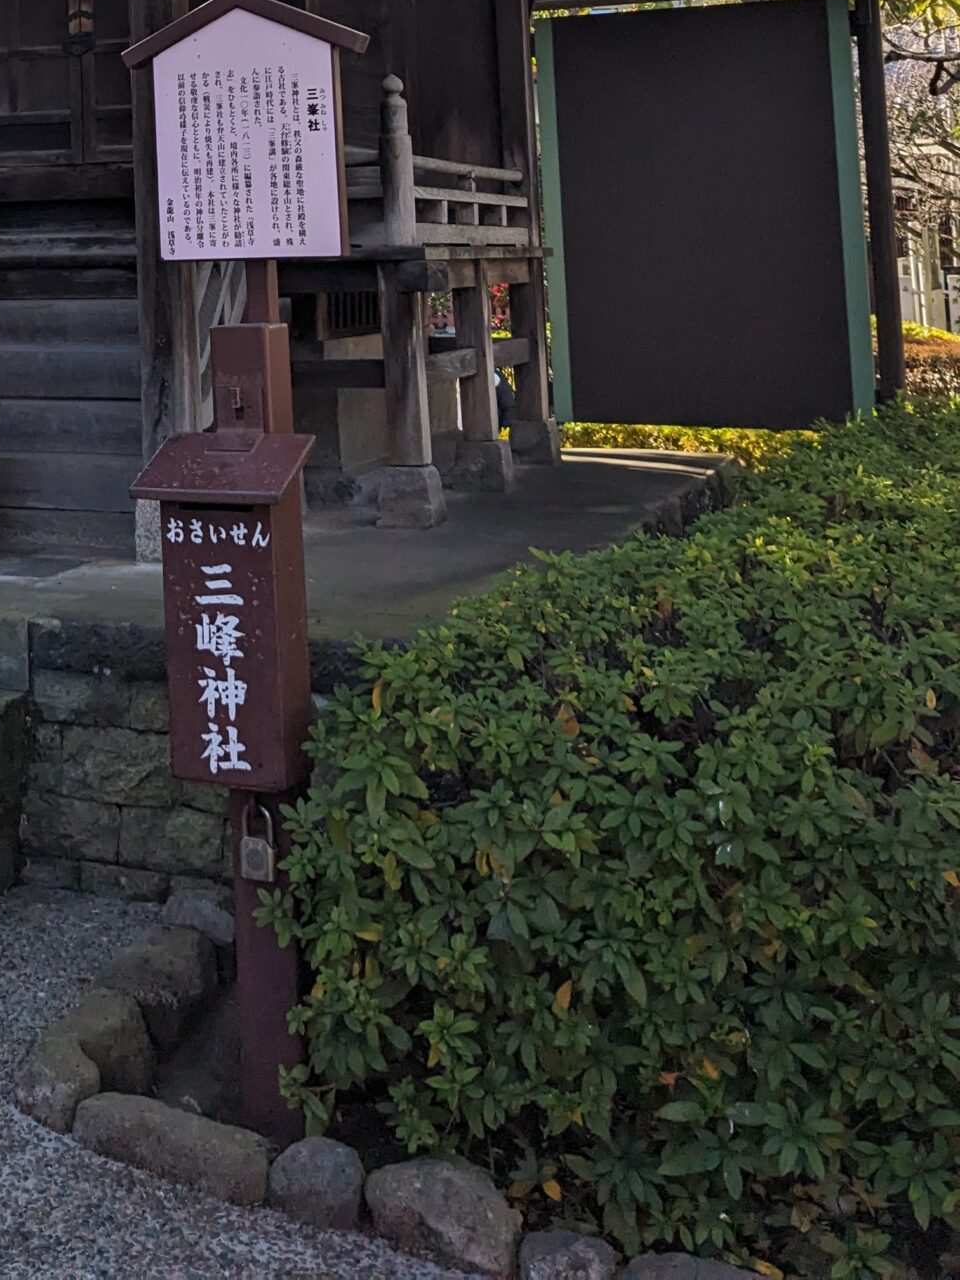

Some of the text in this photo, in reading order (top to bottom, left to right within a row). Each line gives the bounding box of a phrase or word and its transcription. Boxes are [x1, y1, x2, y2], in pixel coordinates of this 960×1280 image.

[306, 88, 320, 132] 三峯社
[166, 517, 270, 548] おさいせん
[195, 563, 251, 774] 三峰神社
